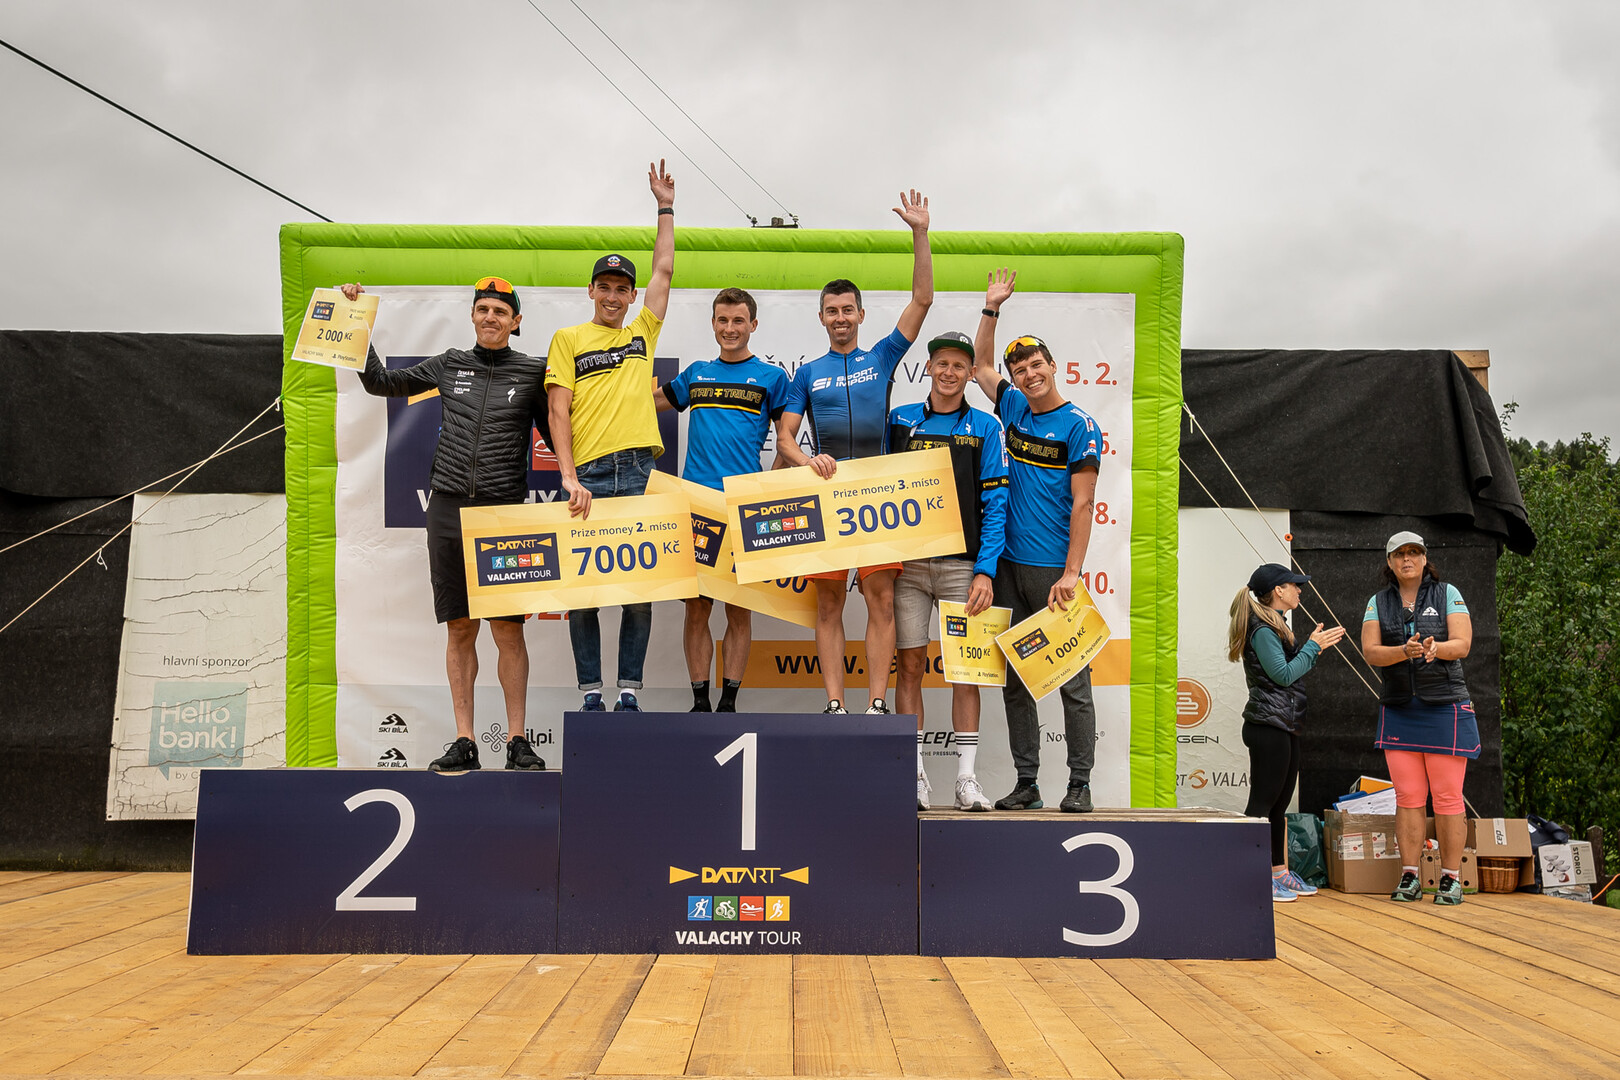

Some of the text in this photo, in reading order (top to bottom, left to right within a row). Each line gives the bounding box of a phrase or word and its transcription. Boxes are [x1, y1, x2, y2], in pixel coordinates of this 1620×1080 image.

[316, 328, 353, 343] 2 000 Kč
[835, 373, 879, 387] IMPORT
[836, 367, 874, 380] SPORT
[1066, 362, 1118, 386] 5. 2.
[833, 477, 940, 499] Prize money 3. místo
[760, 502, 801, 516] DATART
[835, 495, 945, 537] 3000 Kč
[1095, 502, 1117, 525] 8.
[570, 527, 596, 539] Prize
[599, 525, 634, 536] money
[636, 522, 647, 533] 2.
[649, 521, 678, 532] místo
[752, 531, 816, 547] VALACHY TOUR
[497, 539, 538, 551] DATART
[572, 540, 681, 576] 7000 Kč
[694, 551, 709, 562] OUR
[487, 569, 552, 583] VALACHY TOUR
[959, 646, 991, 660] 1 500 Kč
[1045, 626, 1086, 665] 1 000 Kč
[163, 655, 250, 669] hlavní sponzor
[160, 701, 231, 724] Hello
[158, 725, 237, 749] bank!
[175, 772, 187, 780] by
[714, 732, 757, 851] 1
[335, 788, 417, 911] 2
[1572, 846, 1582, 876] STORIO
[701, 866, 782, 884] DATART
[1061, 832, 1140, 947] 3
[675, 931, 801, 945] VALACHY TOUR
